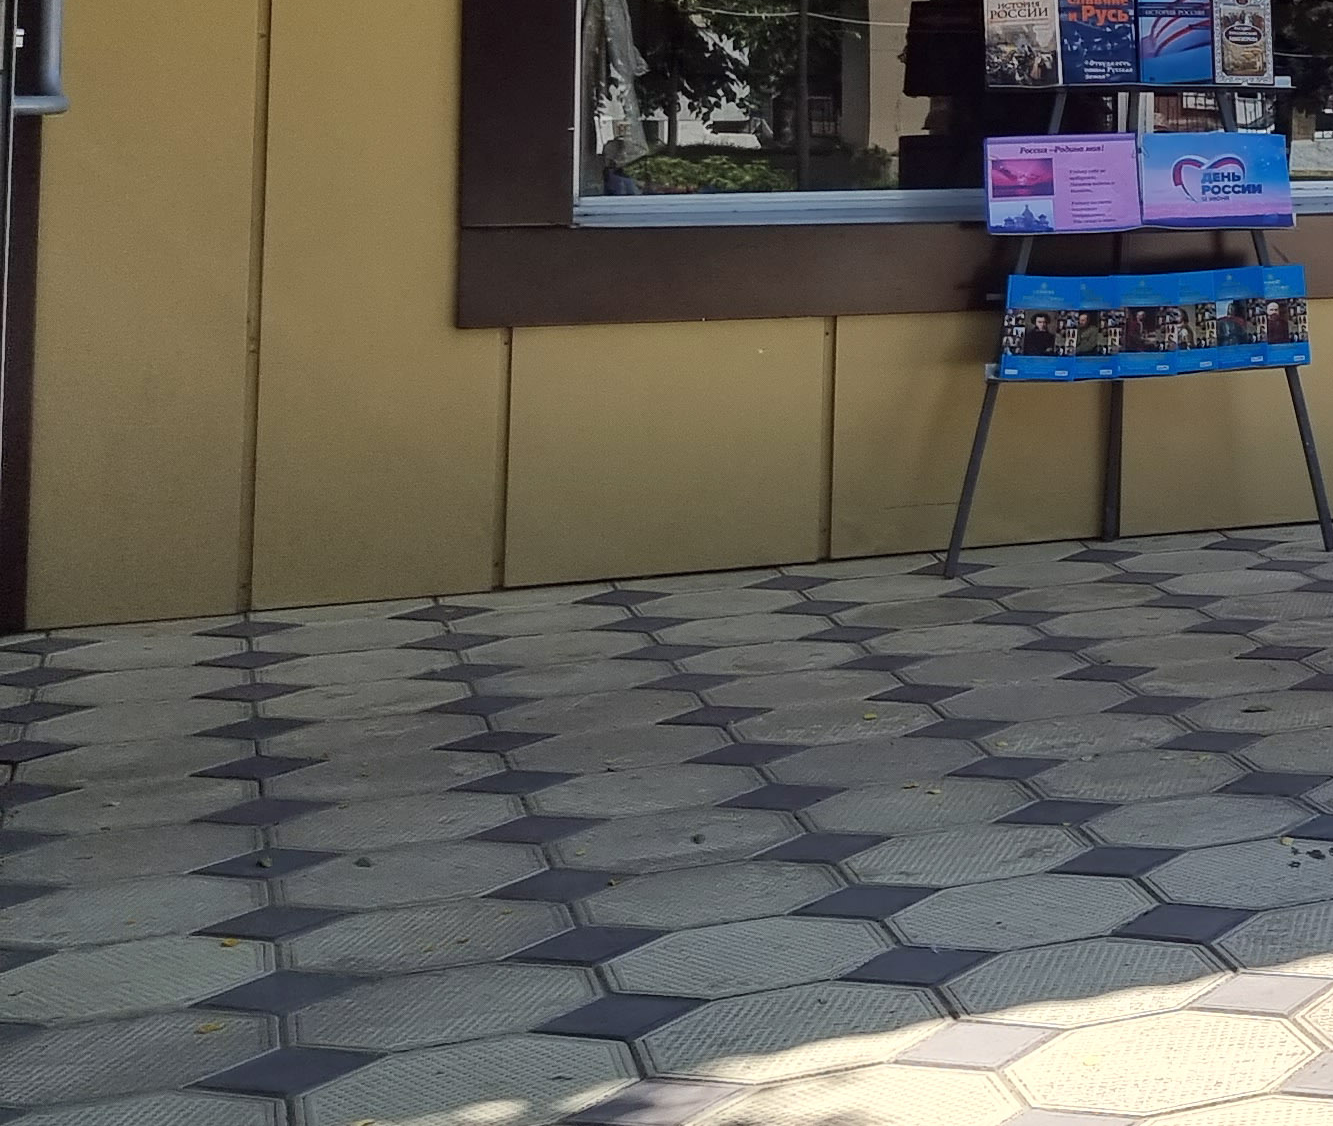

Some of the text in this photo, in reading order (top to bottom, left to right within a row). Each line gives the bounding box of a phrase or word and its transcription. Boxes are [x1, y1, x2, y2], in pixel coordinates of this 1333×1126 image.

[990, 7, 1048, 19] РОССИИ
[1082, 5, 1129, 26] Русь
[1201, 172, 1241, 183] ДЕНЬ
[1201, 184, 1262, 195] РОССИИ
